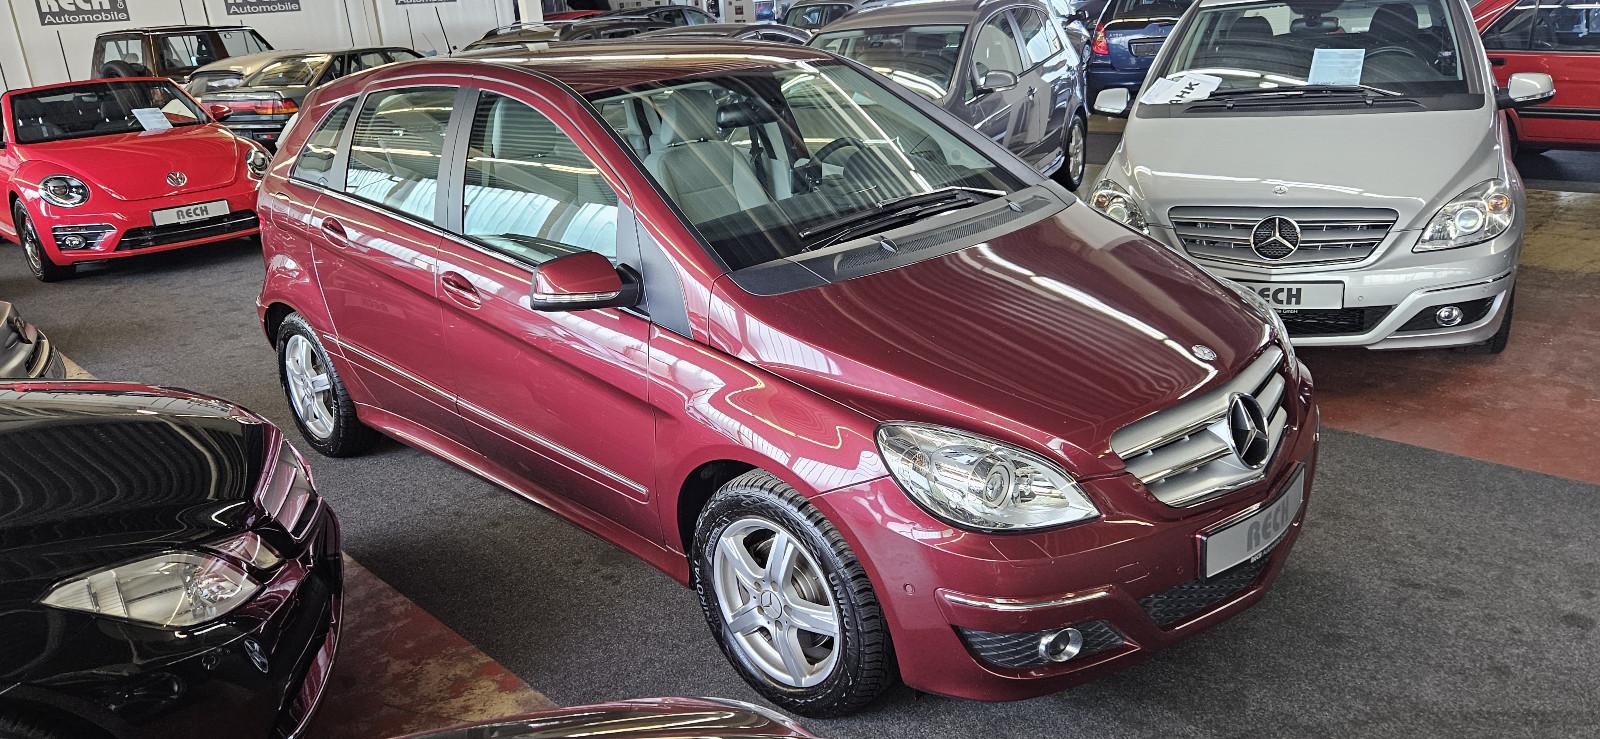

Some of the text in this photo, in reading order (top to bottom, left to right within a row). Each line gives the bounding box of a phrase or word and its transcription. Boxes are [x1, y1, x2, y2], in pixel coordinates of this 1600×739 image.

[230, 3, 298, 14] Automobile
[45, 12, 127, 23] Automobile
[1168, 82, 1200, 105] AHK
[176, 206, 209, 220] RECH
[1246, 286, 1302, 305] ECH
[1247, 495, 1289, 552] RECH
